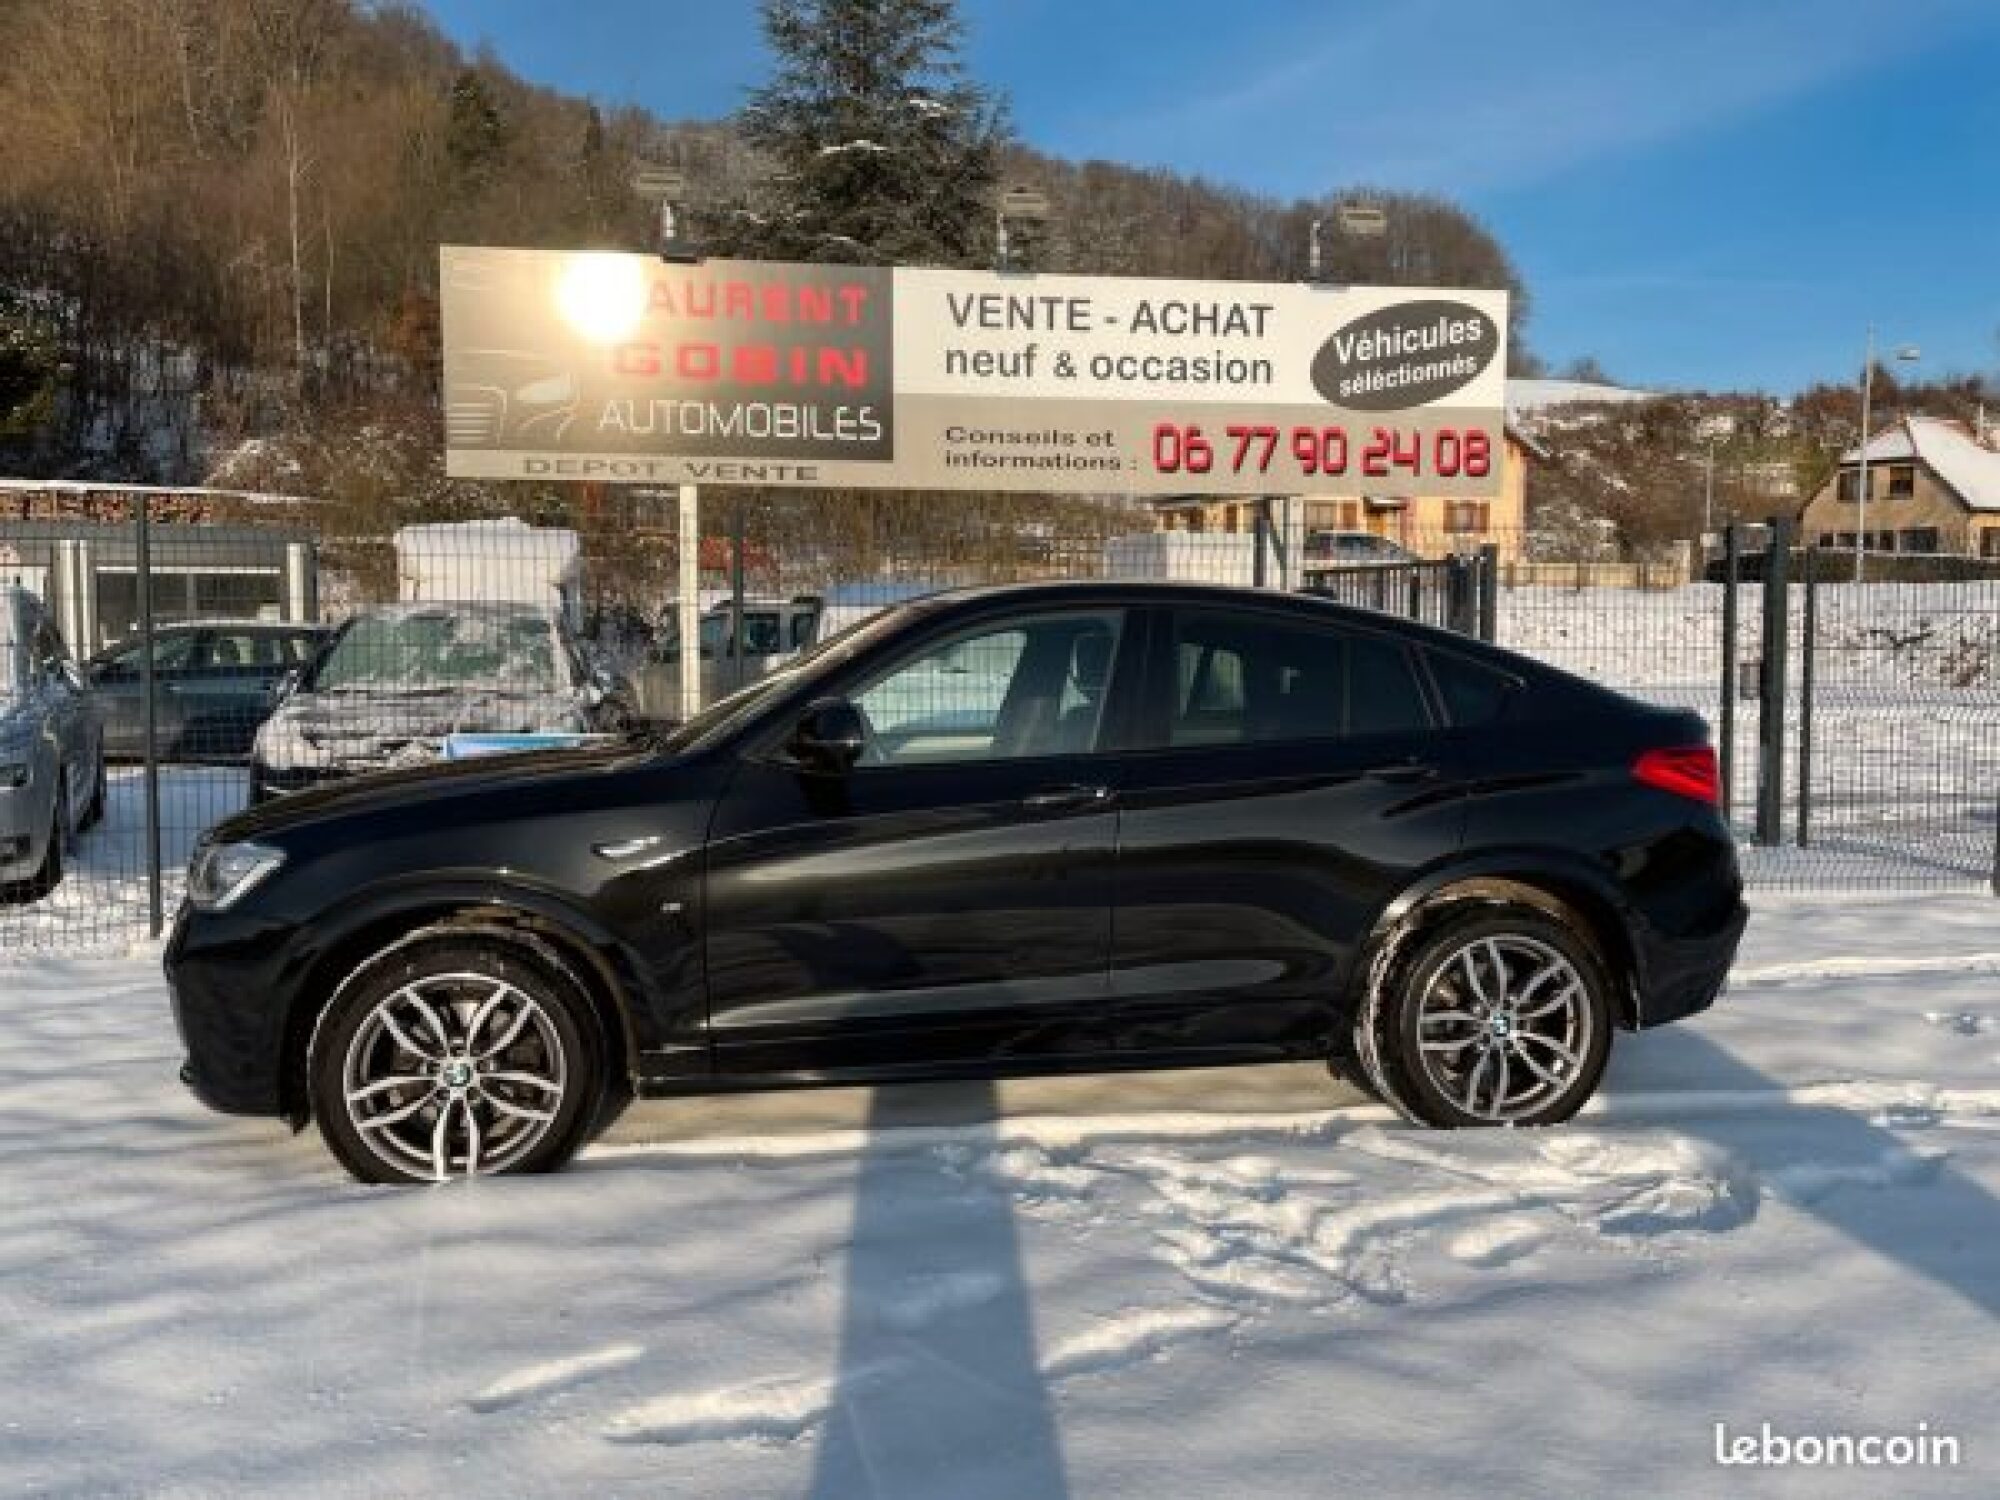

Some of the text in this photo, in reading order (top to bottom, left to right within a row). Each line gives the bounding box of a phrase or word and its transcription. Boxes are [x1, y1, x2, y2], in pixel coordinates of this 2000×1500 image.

[616, 279, 868, 323] AURENT
[946, 292, 1091, 331] VENTE
[1130, 300, 1274, 338] ACHAT
[1332, 317, 1484, 365] Véhicules
[614, 341, 869, 388] GOBIN
[945, 343, 1273, 384] neuf & occasion
[599, 399, 881, 441] AUTOMOBILES
[945, 426, 1115, 448] Conseils et
[523, 457, 818, 481] DEPOT VENTE
[945, 450, 1121, 471] informations
[1152, 422, 1492, 478] 06 77 90 24 08
